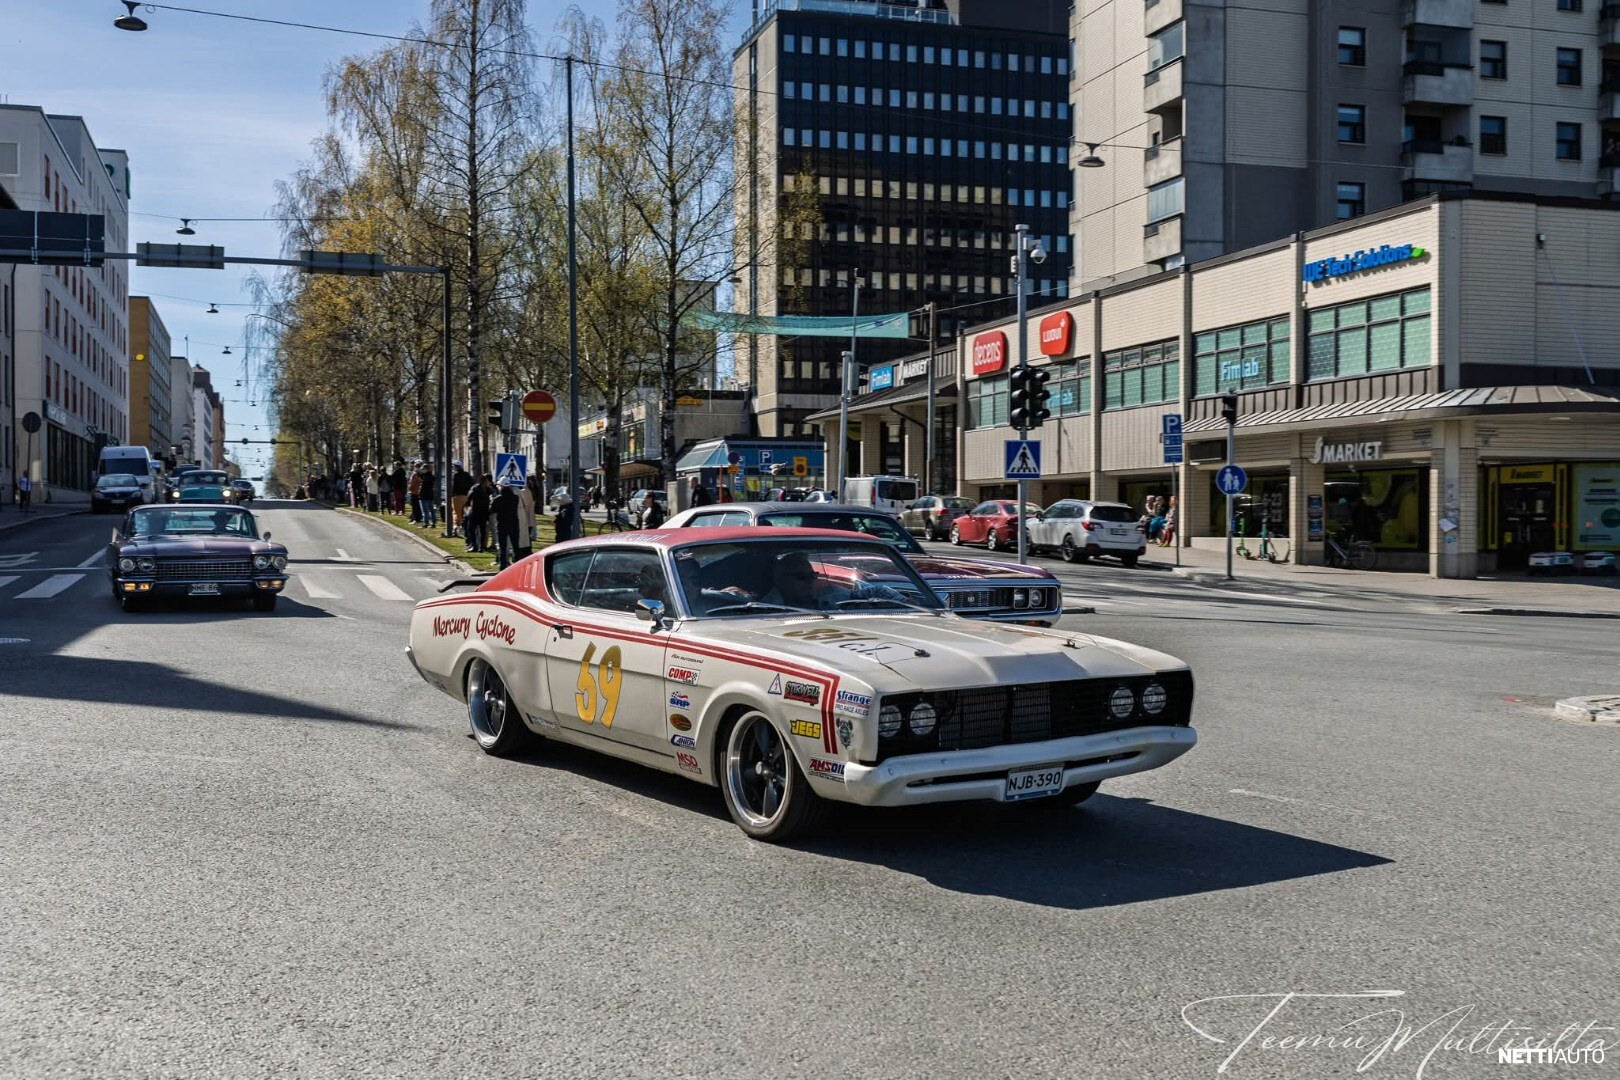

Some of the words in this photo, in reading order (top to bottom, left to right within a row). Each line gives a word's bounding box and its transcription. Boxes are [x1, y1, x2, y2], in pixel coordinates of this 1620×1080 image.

[1353, 243, 1412, 271] Solutions
[974, 340, 1001, 366] decens
[1221, 357, 1259, 381] Fimlab
[1166, 416, 1179, 433] P
[761, 451, 771, 463] P
[433, 615, 471, 639] Mercury
[476, 610, 515, 645] Cyclone
[668, 667, 692, 681] COMP
[837, 689, 872, 705] Strange
[791, 719, 821, 738] JEGS
[676, 751, 698, 768] MSD
[1009, 771, 1061, 791] NJB-390
